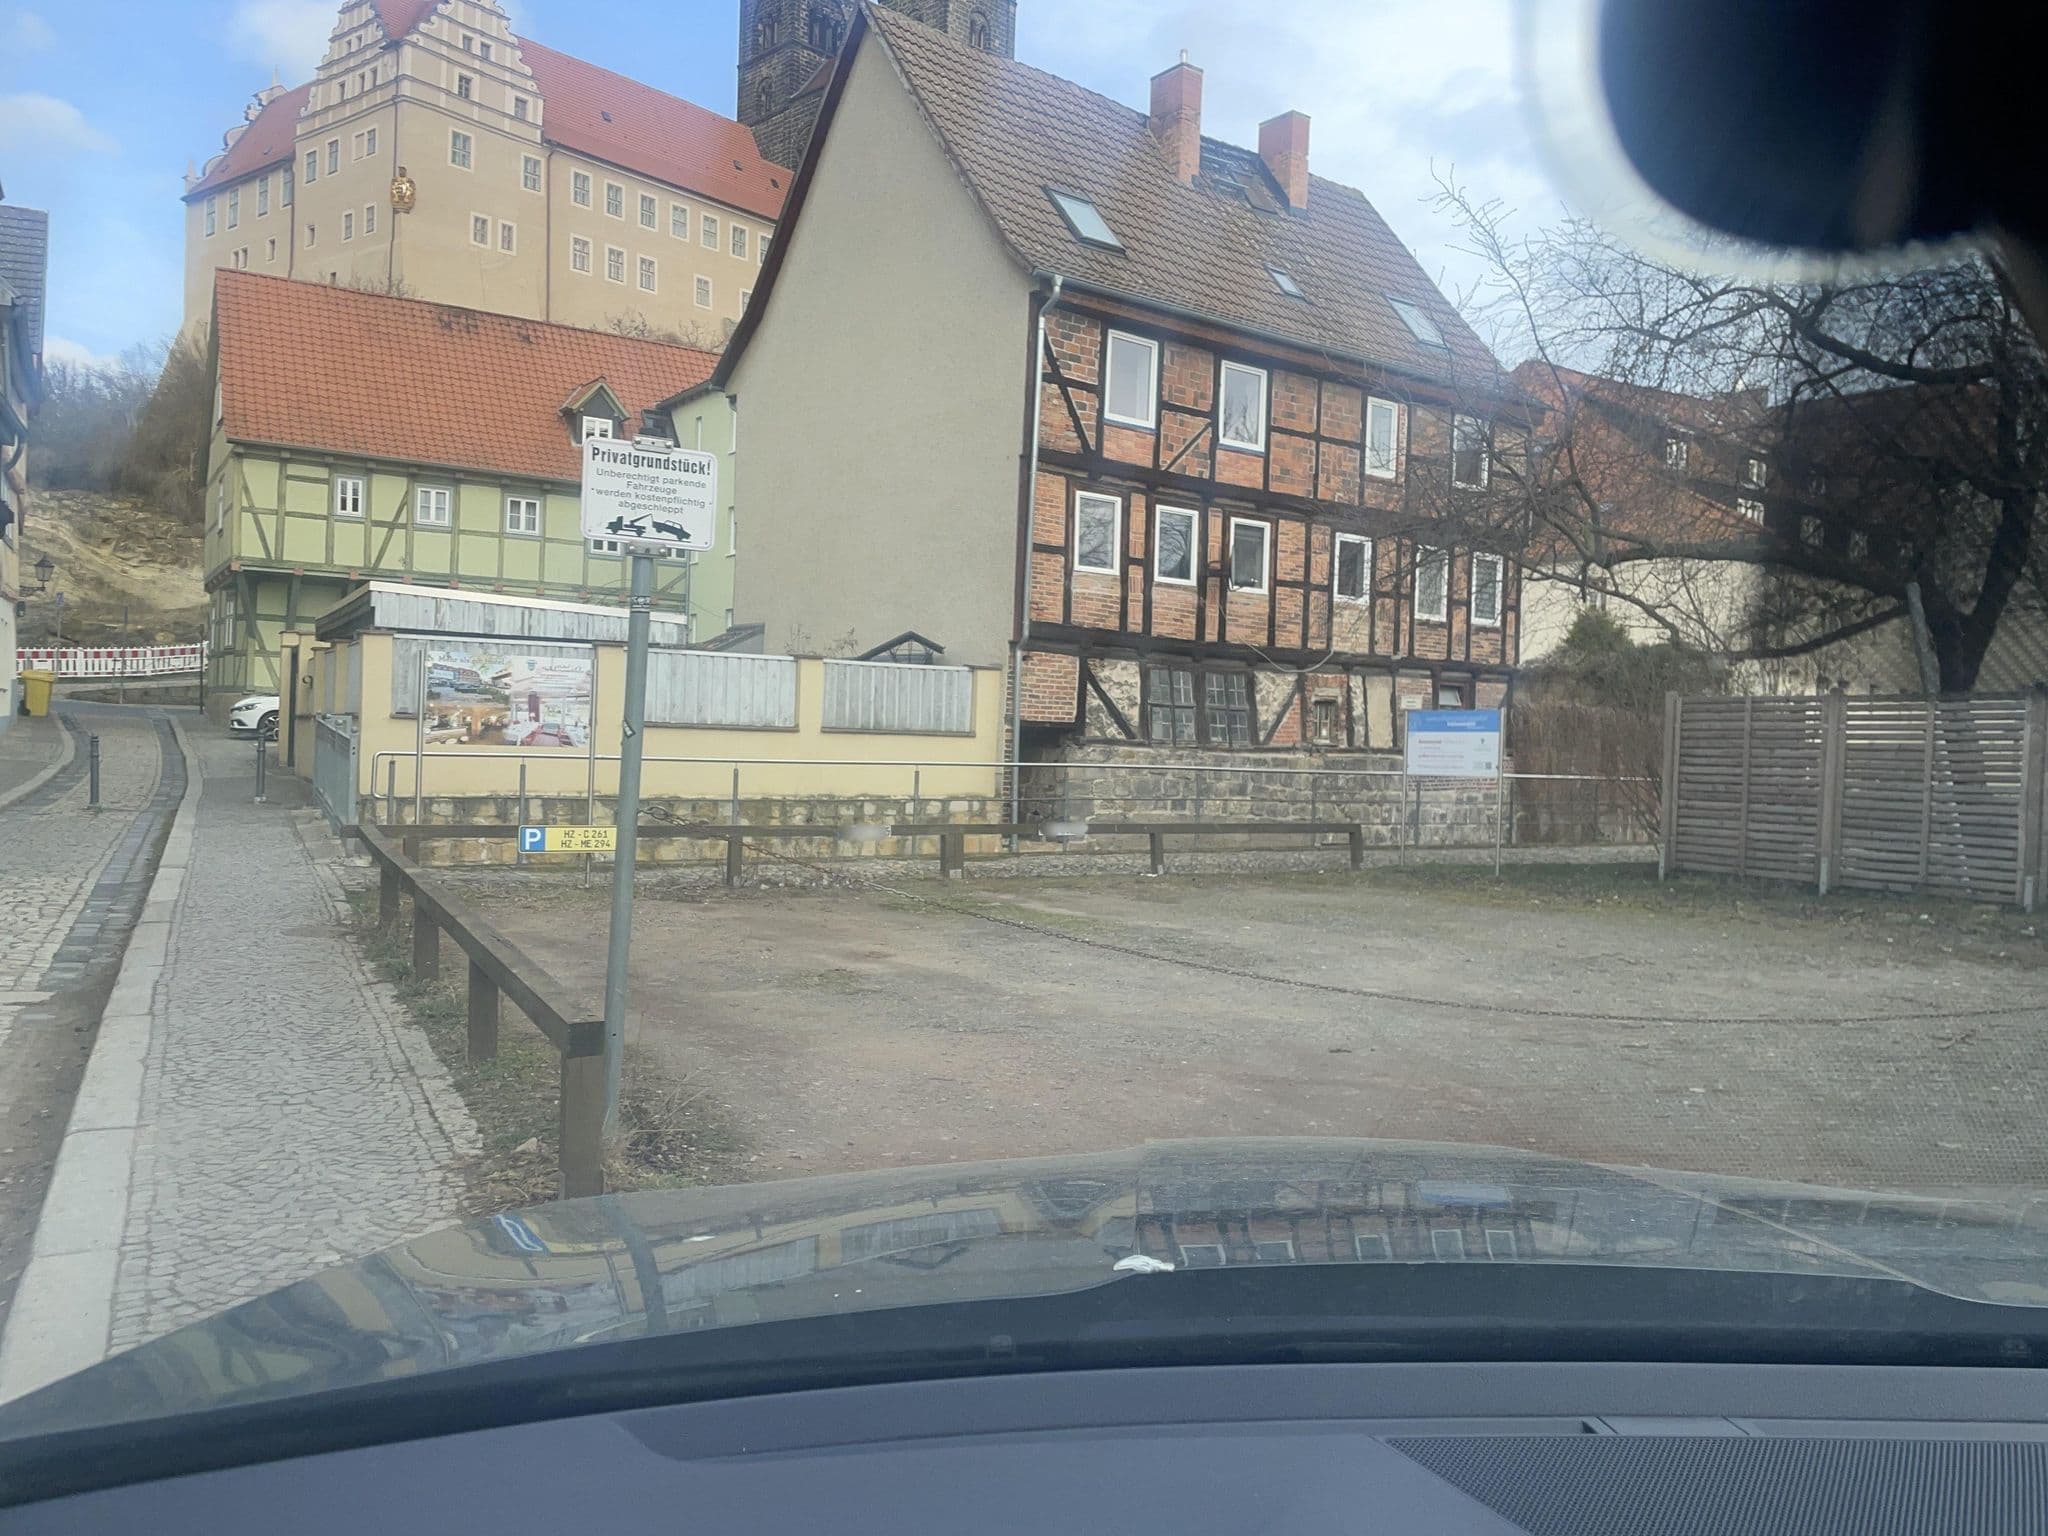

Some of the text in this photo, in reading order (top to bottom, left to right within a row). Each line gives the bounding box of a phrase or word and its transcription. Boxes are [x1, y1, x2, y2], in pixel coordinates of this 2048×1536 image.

[592, 447, 711, 475] Privatgrundstück!
[596, 468, 707, 489] Unberechtigt parkende
[626, 481, 678, 495] Fahrzeuge
[595, 488, 706, 508] werden kostenpflichtig
[618, 500, 684, 514] abgeschleppt
[525, 828, 541, 850] P
[563, 830, 576, 839] HZ
[591, 830, 608, 839] 261
[560, 840, 573, 848] HZ
[594, 840, 611, 848] 294
